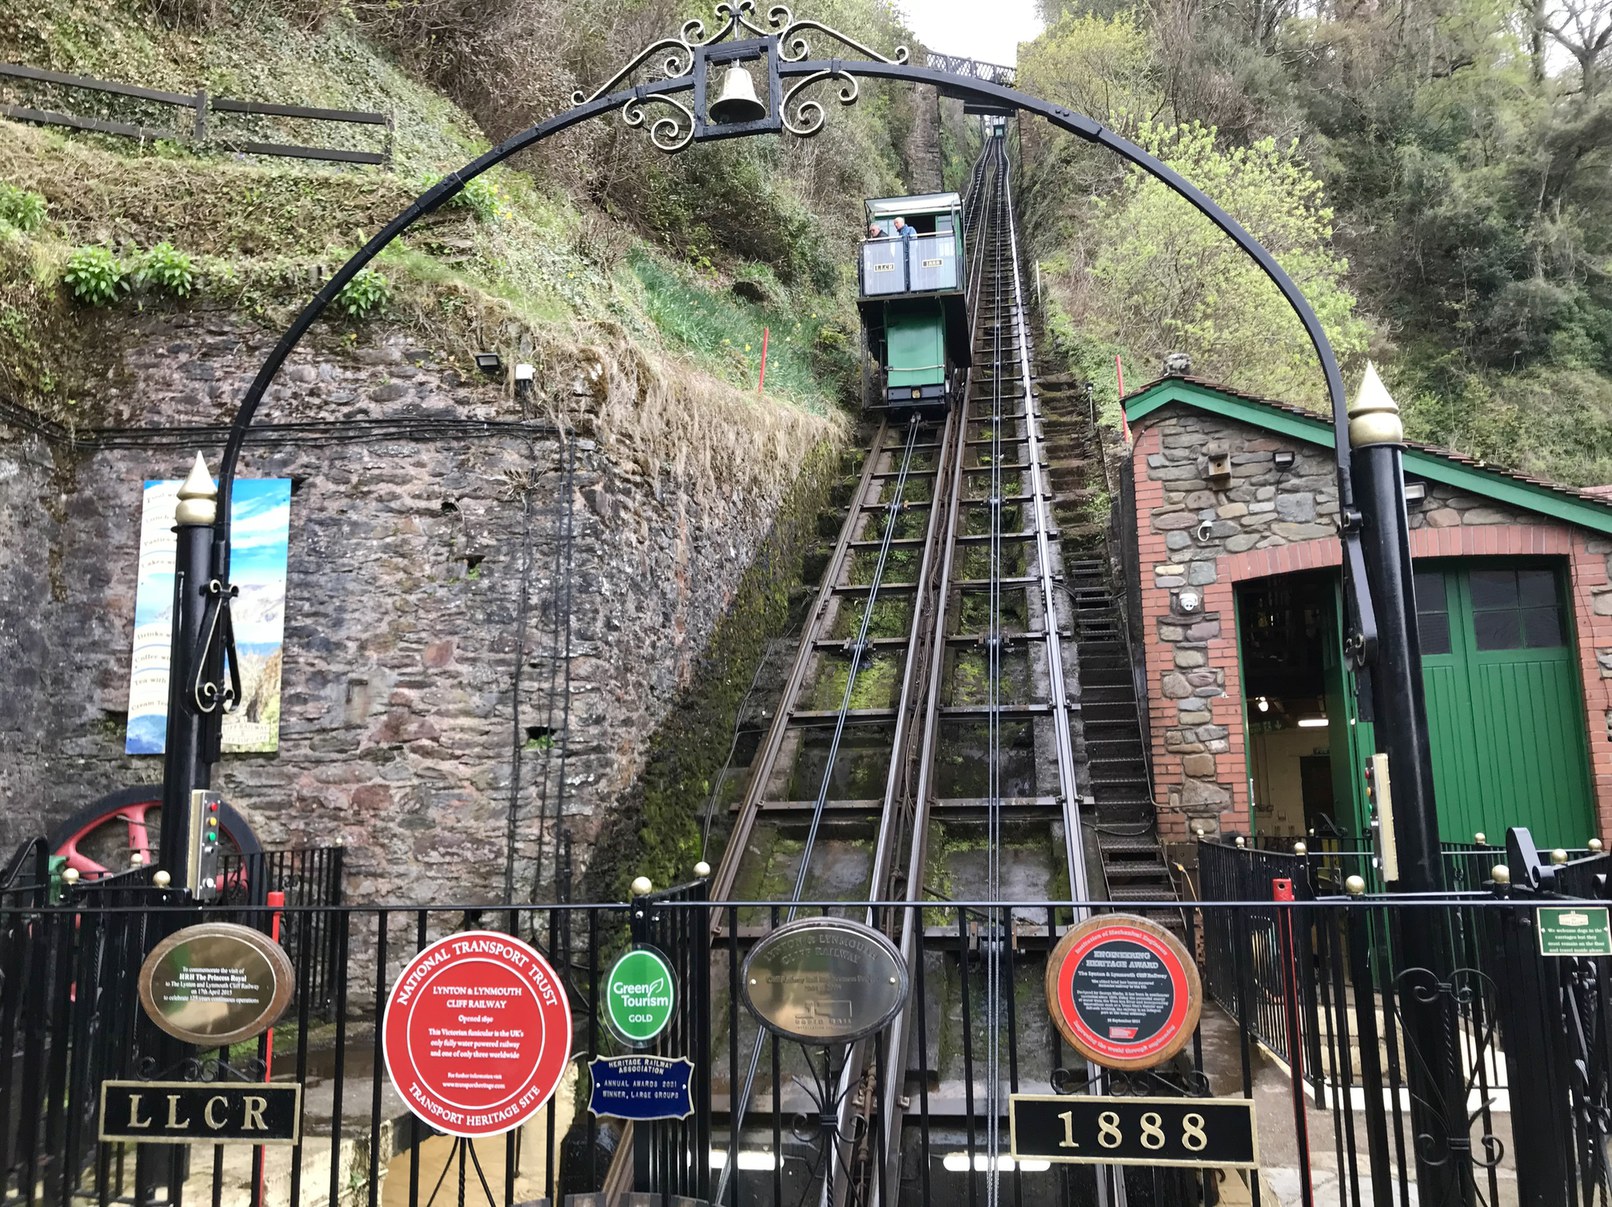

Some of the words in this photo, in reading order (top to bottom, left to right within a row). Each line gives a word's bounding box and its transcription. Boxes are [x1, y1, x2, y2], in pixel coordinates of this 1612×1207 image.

[135, 654, 158, 663] Coffee
[131, 701, 155, 711] Cream
[763, 938, 803, 961] LYNTON
[819, 934, 878, 961] LYNMOUTH
[1074, 934, 1102, 954] Institution
[1109, 929, 1142, 938] Mechanical
[1143, 935, 1168, 956] Engineers
[815, 946, 859, 964] RAILWAY
[1094, 950, 1150, 960] ENGINEERING
[1086, 960, 1127, 968] HERITAGE
[1129, 961, 1159, 969] AWARD
[397, 948, 450, 1006] NATIONAL
[452, 940, 529, 968] TRANSPORT
[528, 964, 558, 1006] TRUST
[433, 986, 466, 995] LYNTON
[474, 987, 522, 996] LYNMOUTH
[613, 982, 649, 994] Green
[446, 999, 467, 1008] CLIFF
[468, 1000, 507, 1009] RAILWAY
[621, 995, 669, 1007] Tourism
[458, 1014, 480, 1024] Opened
[628, 1014, 653, 1023] GOLD
[441, 1028, 468, 1036] Victorian
[468, 1028, 494, 1037] funicular
[430, 1039, 443, 1048] only
[444, 1039, 457, 1048] fully
[474, 1040, 498, 1049] powered
[499, 1041, 520, 1050] railway
[460, 1050, 473, 1059] only
[608, 1058, 642, 1069] HERITAGE
[644, 1058, 673, 1070] RAILWAY
[618, 1066, 665, 1075] ASSOCIATION
[604, 1080, 629, 1088] ANNUAL
[602, 1090, 629, 1100] WINNER,
[630, 1091, 651, 1099] LARGE
[654, 1091, 679, 1099] GROUPS
[408, 1082, 464, 1125] TRANSPORT
[466, 1103, 520, 1126] HERITAGE
[519, 1084, 542, 1108] SITE
[127, 1094, 269, 1130] LLCR
[1057, 1110, 1208, 1151] 1888
